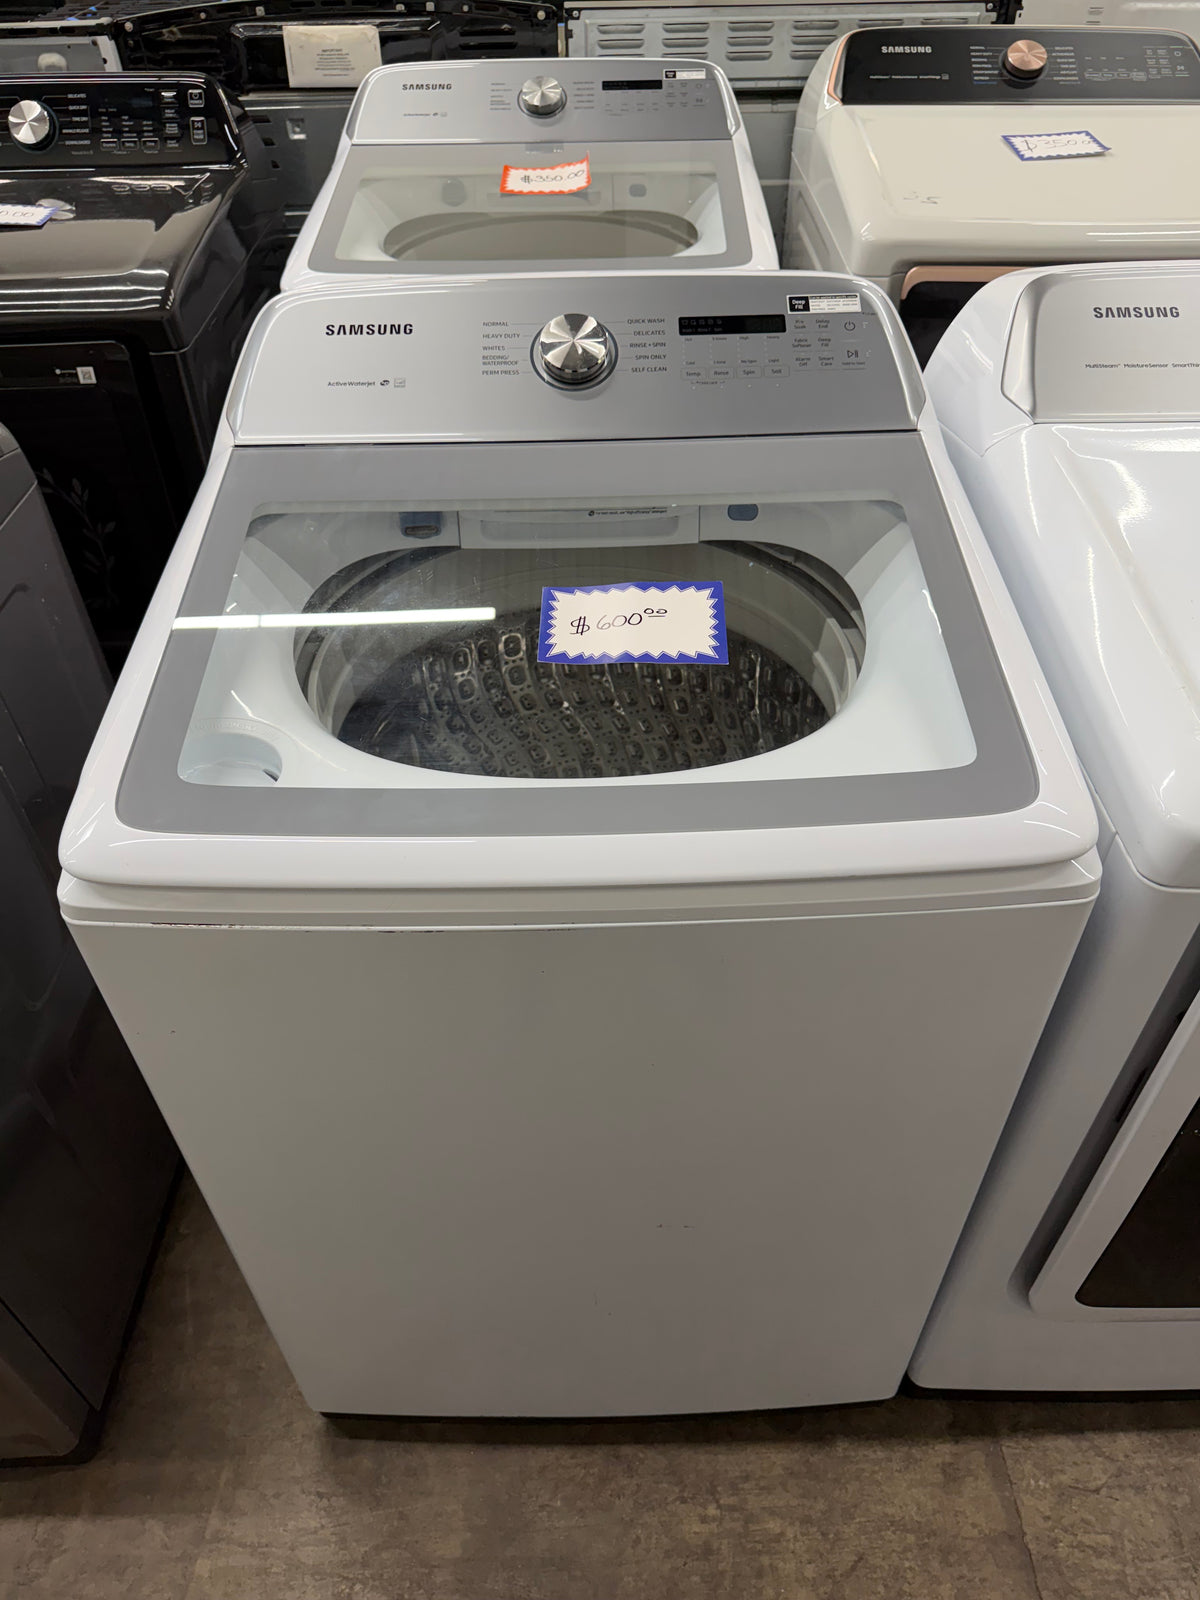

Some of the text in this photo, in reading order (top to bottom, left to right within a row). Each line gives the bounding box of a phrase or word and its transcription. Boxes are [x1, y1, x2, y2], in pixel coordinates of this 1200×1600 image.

[880, 45, 933, 54] SAMSUNG
[402, 83, 453, 91] SAMSUNG
[1093, 306, 1180, 318] SAMSUNG
[325, 323, 414, 336] SAMSUNG
